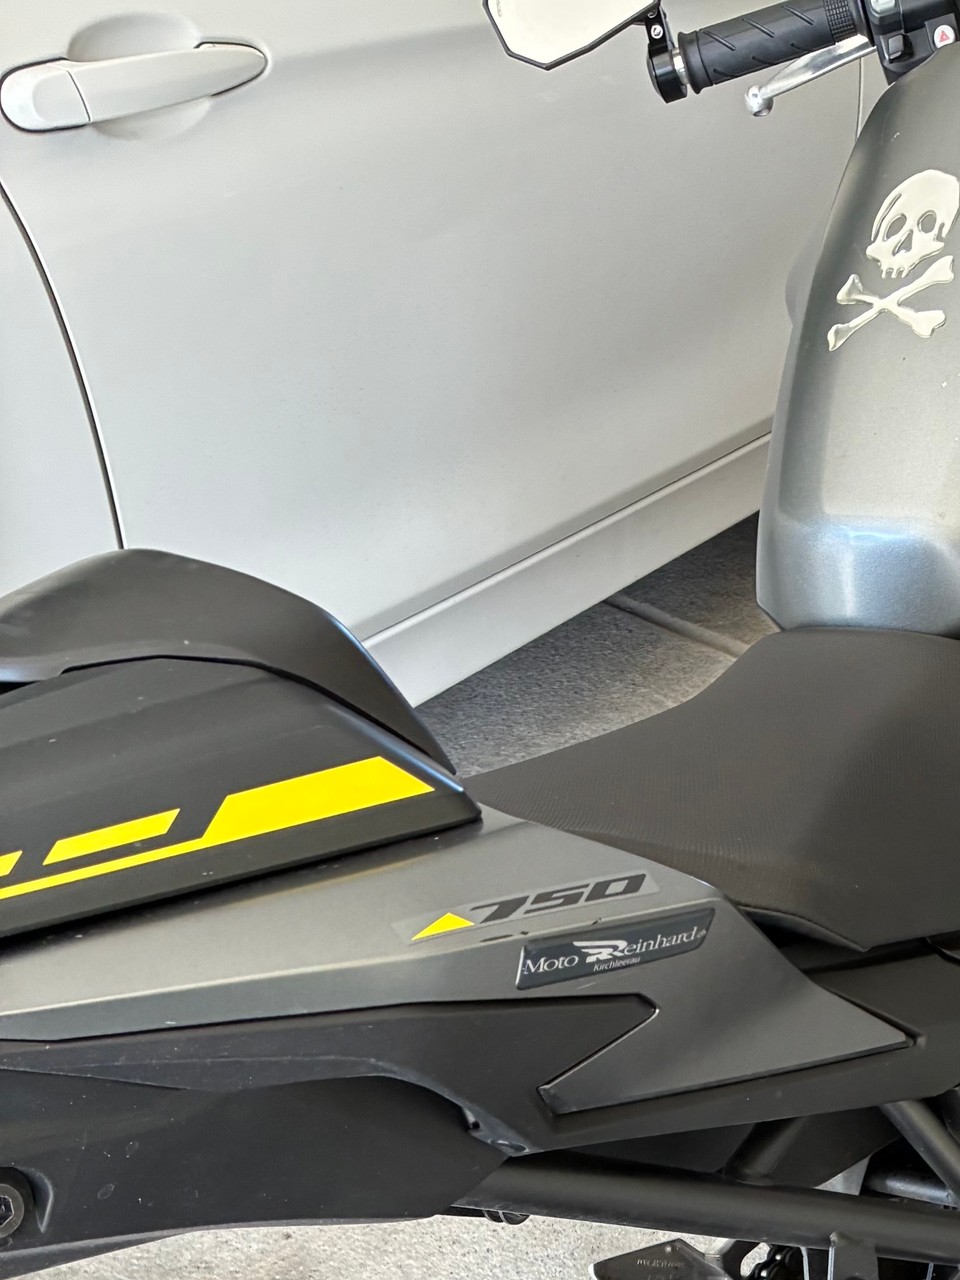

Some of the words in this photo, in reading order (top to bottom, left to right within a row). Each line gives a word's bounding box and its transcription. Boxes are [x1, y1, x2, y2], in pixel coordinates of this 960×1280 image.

[470, 873, 647, 924] 750
[523, 954, 579, 975] Moto
[573, 925, 698, 963] Reinhard
[593, 955, 641, 972] Kirchleerau
